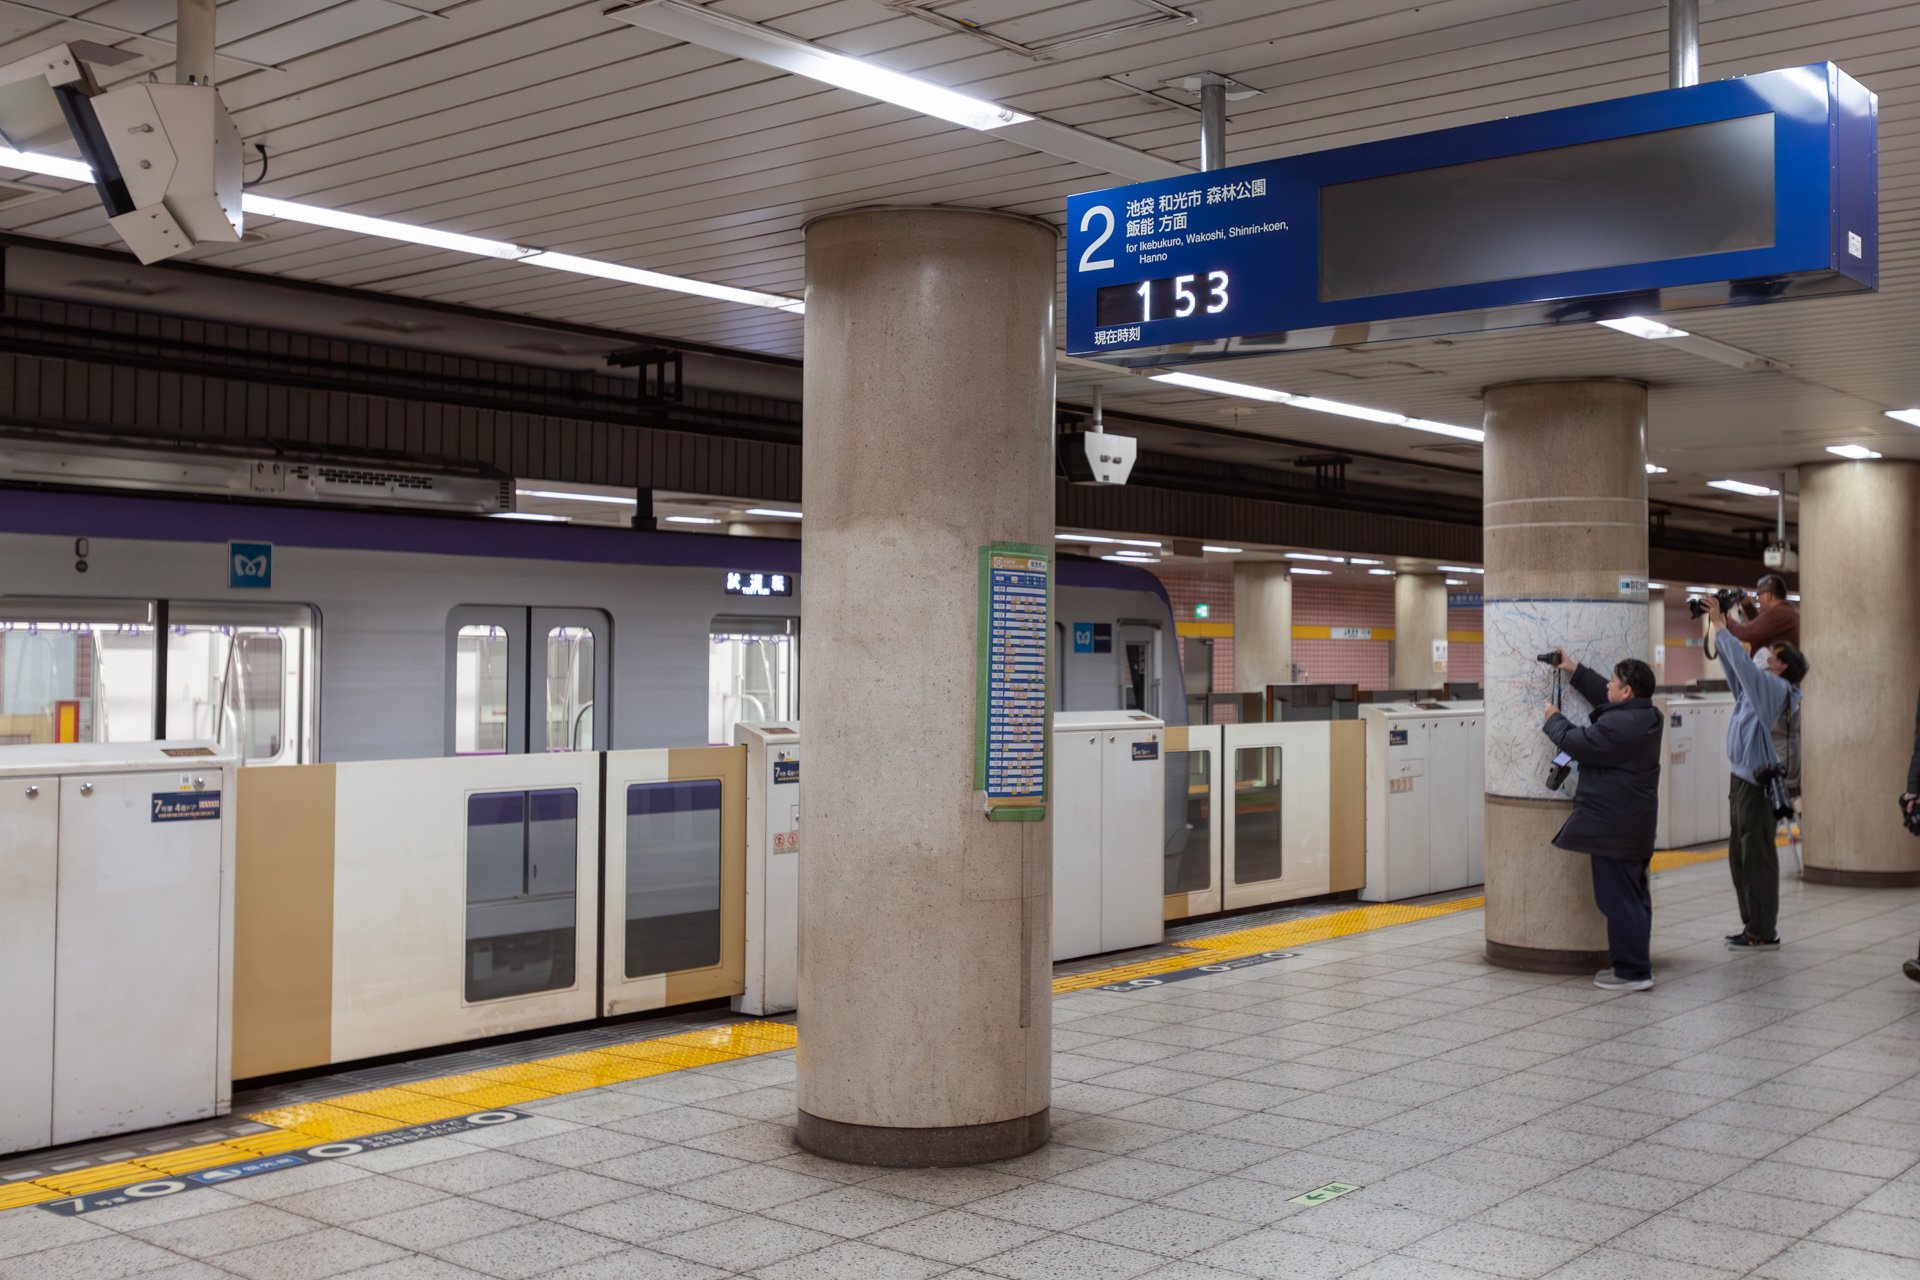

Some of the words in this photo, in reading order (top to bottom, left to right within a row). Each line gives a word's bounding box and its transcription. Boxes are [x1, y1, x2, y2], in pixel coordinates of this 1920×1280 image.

[1126, 197, 1155, 218] 池袋
[1158, 189, 1202, 213] 和光市
[1206, 178, 1266, 205] 森林公園
[1078, 205, 1115, 273] 2
[1126, 218, 1155, 237] 飯能
[1158, 212, 1188, 232] 方面
[1126, 243, 1138, 253] for
[1139, 236, 1184, 251] Ikebukuro,
[1185, 229, 1226, 244] Wakoshi,
[1228, 220, 1289, 238] Shinrin-koen,
[1139, 252, 1168, 264] Hanno
[1094, 326, 1141, 346] 現在時刻
